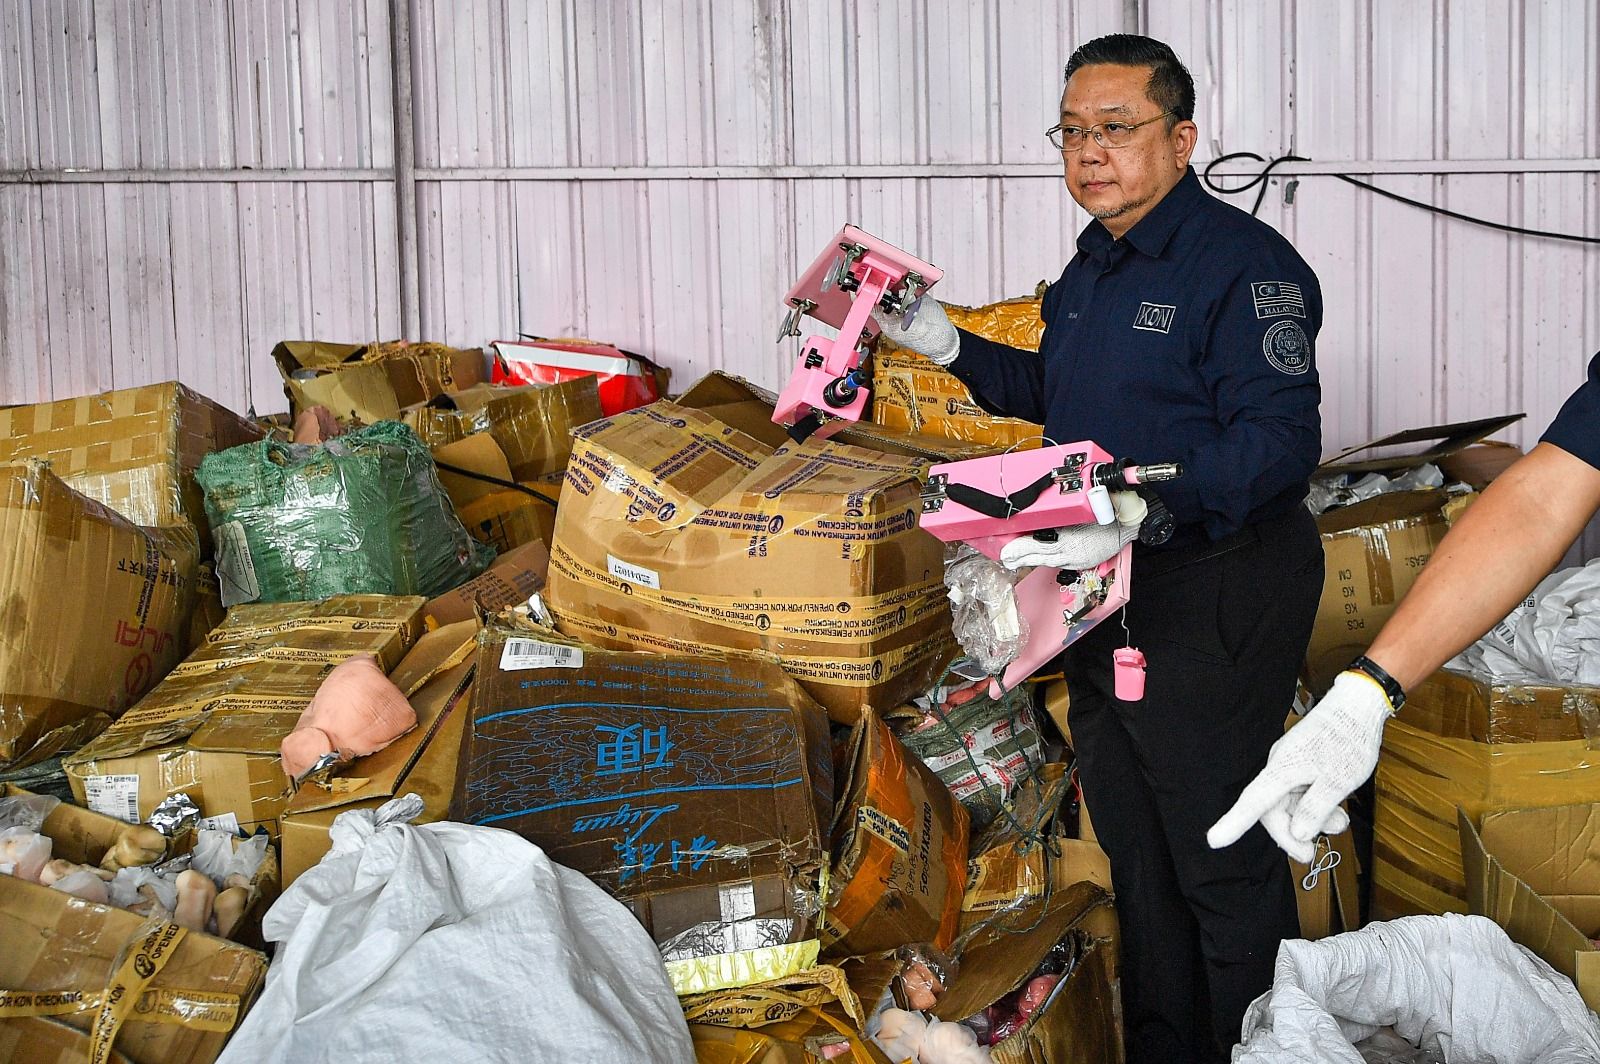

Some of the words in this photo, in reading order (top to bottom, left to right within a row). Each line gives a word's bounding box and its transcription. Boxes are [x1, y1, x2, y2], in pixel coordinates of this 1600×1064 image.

[1264, 306, 1300, 315] MALAYSIA
[1138, 305, 1170, 328] KDN
[1284, 357, 1302, 365] KDN
[585, 450, 611, 471] CHECKING
[639, 484, 663, 504] OPENED
[713, 510, 728, 519] KDN
[729, 511, 743, 521] FOR
[744, 513, 770, 523] OPENED
[886, 513, 905, 527] OPENED
[693, 517, 721, 528] PEMERI
[722, 520, 741, 531] UNTUK
[742, 522, 767, 532] DIBUKA
[817, 520, 856, 530] CHECKING
[857, 522, 873, 531] KDN
[873, 520, 886, 530] FOR
[793, 528, 810, 537] KDN
[867, 528, 887, 541] UNTUK
[888, 523, 906, 537] DIBUKA
[811, 530, 866, 542] PEMERIKSAAN
[572, 560, 583, 571] KDN
[583, 567, 596, 578] FOR
[1338, 569, 1352, 581] CM
[596, 572, 619, 587] OPENED
[1342, 585, 1355, 598] KG
[694, 603, 709, 612] KDN
[710, 608, 724, 617] FOR
[732, 602, 769, 612] CHECKING
[770, 603, 787, 612] KDN
[787, 603, 802, 612] FOR
[804, 603, 834, 612] OPENED
[1344, 602, 1358, 615] KG
[726, 610, 754, 621] OPENED
[805, 619, 843, 629] CHECKING
[844, 619, 860, 629] KDN
[860, 618, 875, 629] FOR
[1346, 618, 1365, 631] PCS
[800, 627, 853, 638] PEMERIKSAAN
[854, 626, 878, 638] UNTUK
[841, 663, 871, 672] OPENED
[819, 671, 844, 681] UNTUK
[844, 672, 871, 681] DIBUKA
[593, 722, 675, 778] 硬
[571, 804, 681, 844] Liqun
[866, 808, 888, 829] UNTUK
[872, 823, 885, 836] FOR
[152, 923, 180, 960] OPENED
[14, 995, 33, 1007] KDN
[35, 990, 82, 1007] CHECKING
[109, 983, 126, 1005] KDN
[703, 1007, 733, 1018] SAAN
[735, 1007, 753, 1015] KDN
